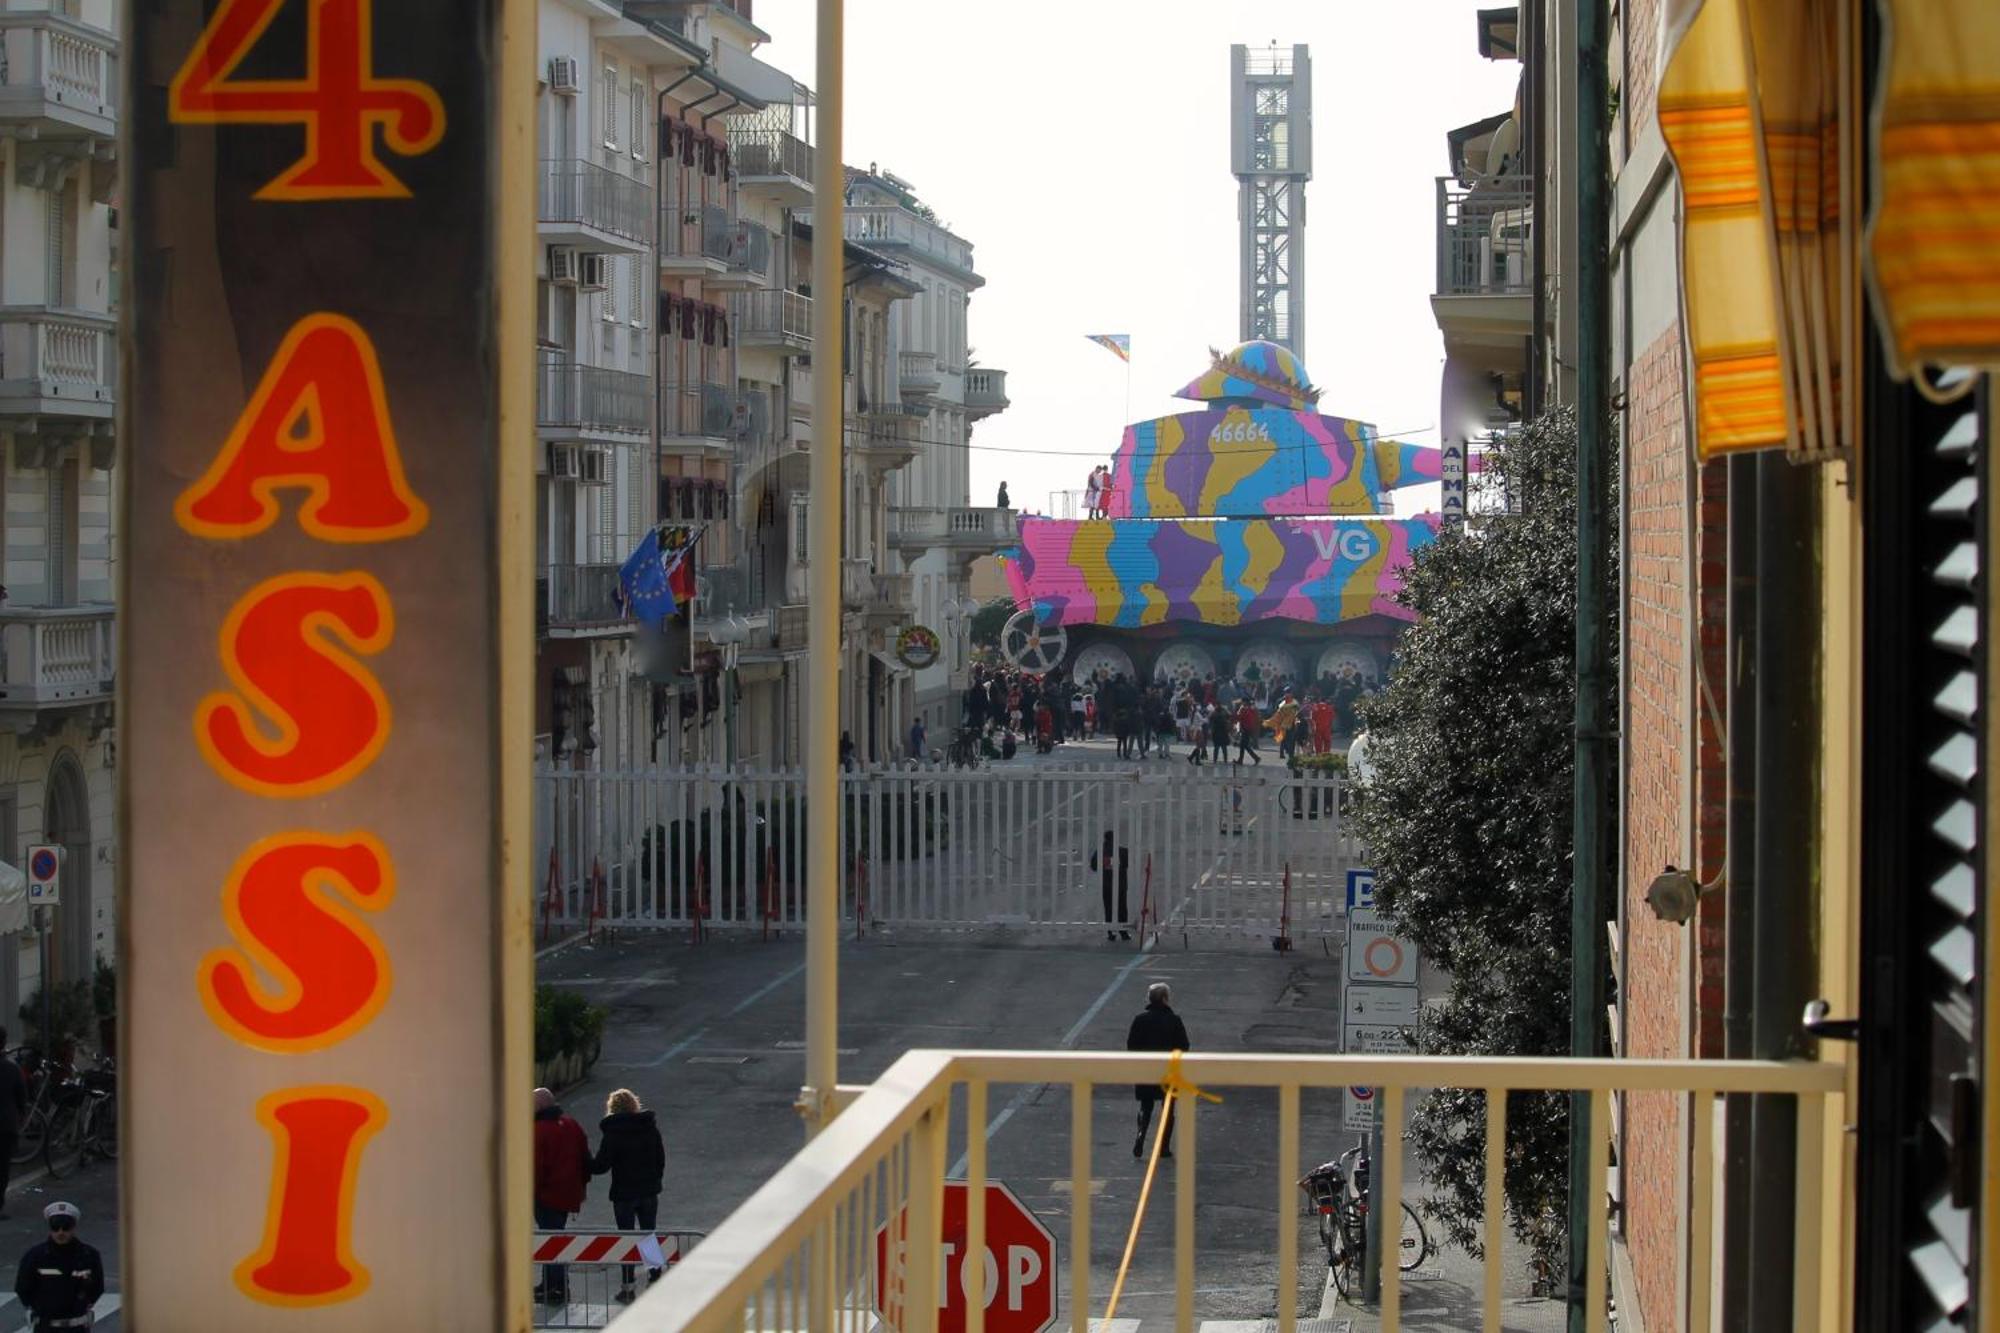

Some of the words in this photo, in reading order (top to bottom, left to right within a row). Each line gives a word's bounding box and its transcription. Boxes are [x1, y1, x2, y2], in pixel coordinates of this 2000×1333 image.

[168, 0, 447, 202] 4
[1210, 422, 1270, 442] 46664
[1442, 464, 1463, 473] DEL
[1312, 529, 1371, 561] VG
[173, 311, 430, 1309] ASSI
